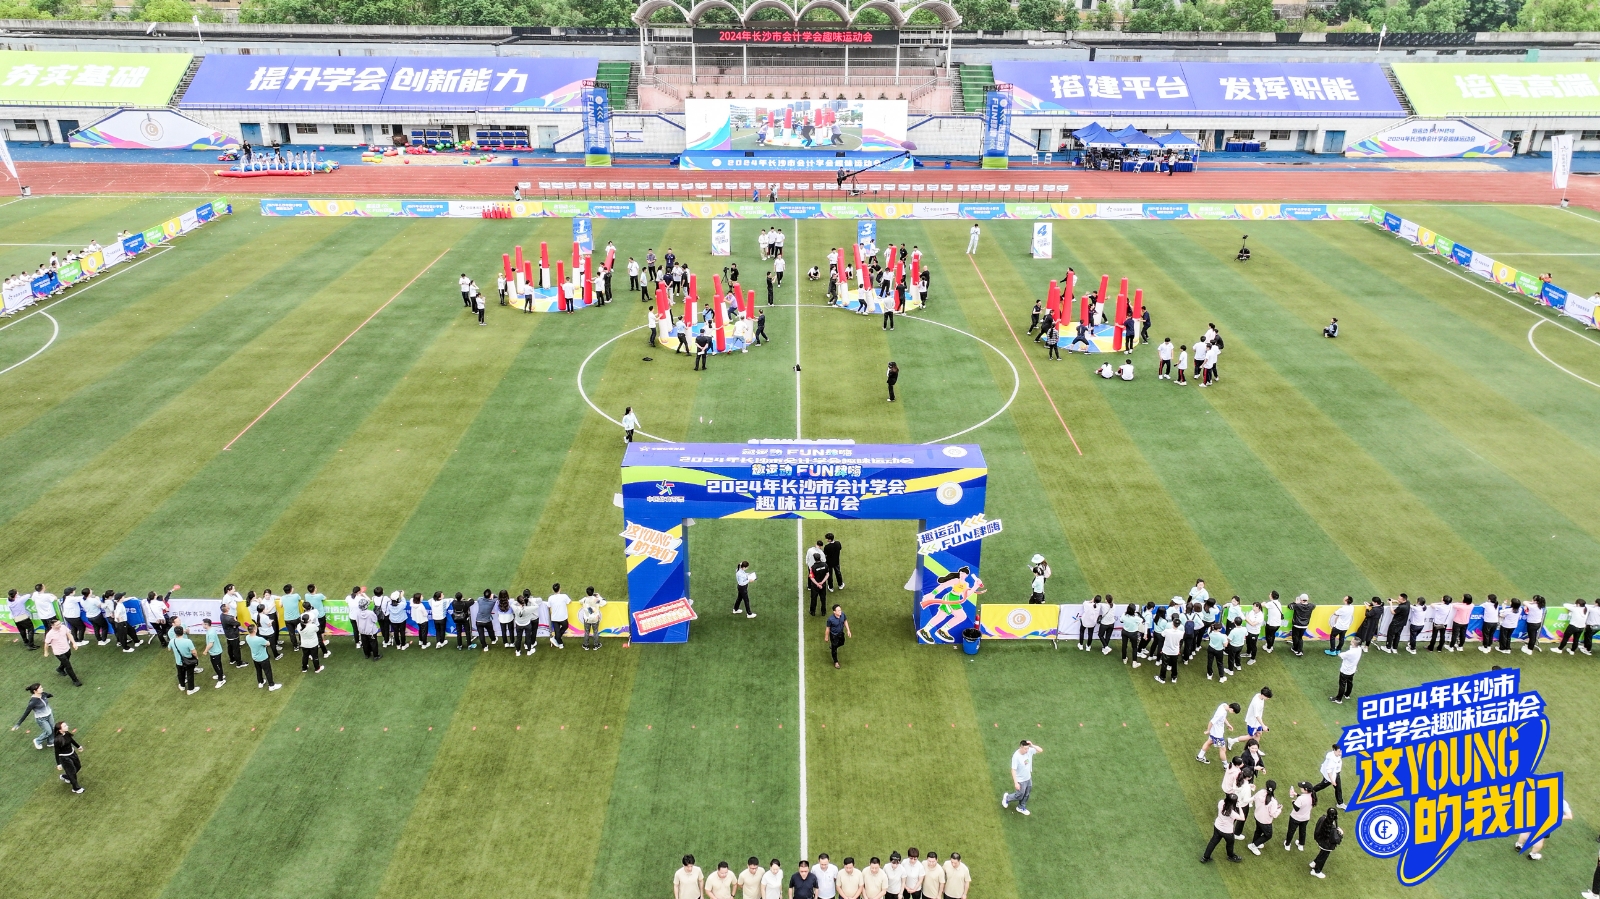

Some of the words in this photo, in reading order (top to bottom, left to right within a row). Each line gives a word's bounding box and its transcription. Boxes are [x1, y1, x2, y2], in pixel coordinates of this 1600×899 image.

[719, 31, 873, 42] 2024年长沙市会计学会趣味运动会
[2, 64, 150, 88] 夯实基础
[246, 67, 389, 92] 提升学会
[389, 68, 528, 92] 创新能力
[1453, 73, 1600, 98] 培育高端
[1050, 75, 1190, 99] 搭建平台
[1219, 76, 1360, 101] 发挥职能
[576, 219, 587, 234] 1
[715, 222, 726, 234] 2
[860, 222, 873, 236] 3
[1037, 224, 1048, 237] 4
[706, 479, 907, 496] 2024年长沙市会计学会
[755, 495, 861, 512] 趣味运动会
[921, 523, 961, 544] 趣运动
[941, 521, 1001, 549] FUN肆嗨
[632, 540, 678, 563] 的我们
